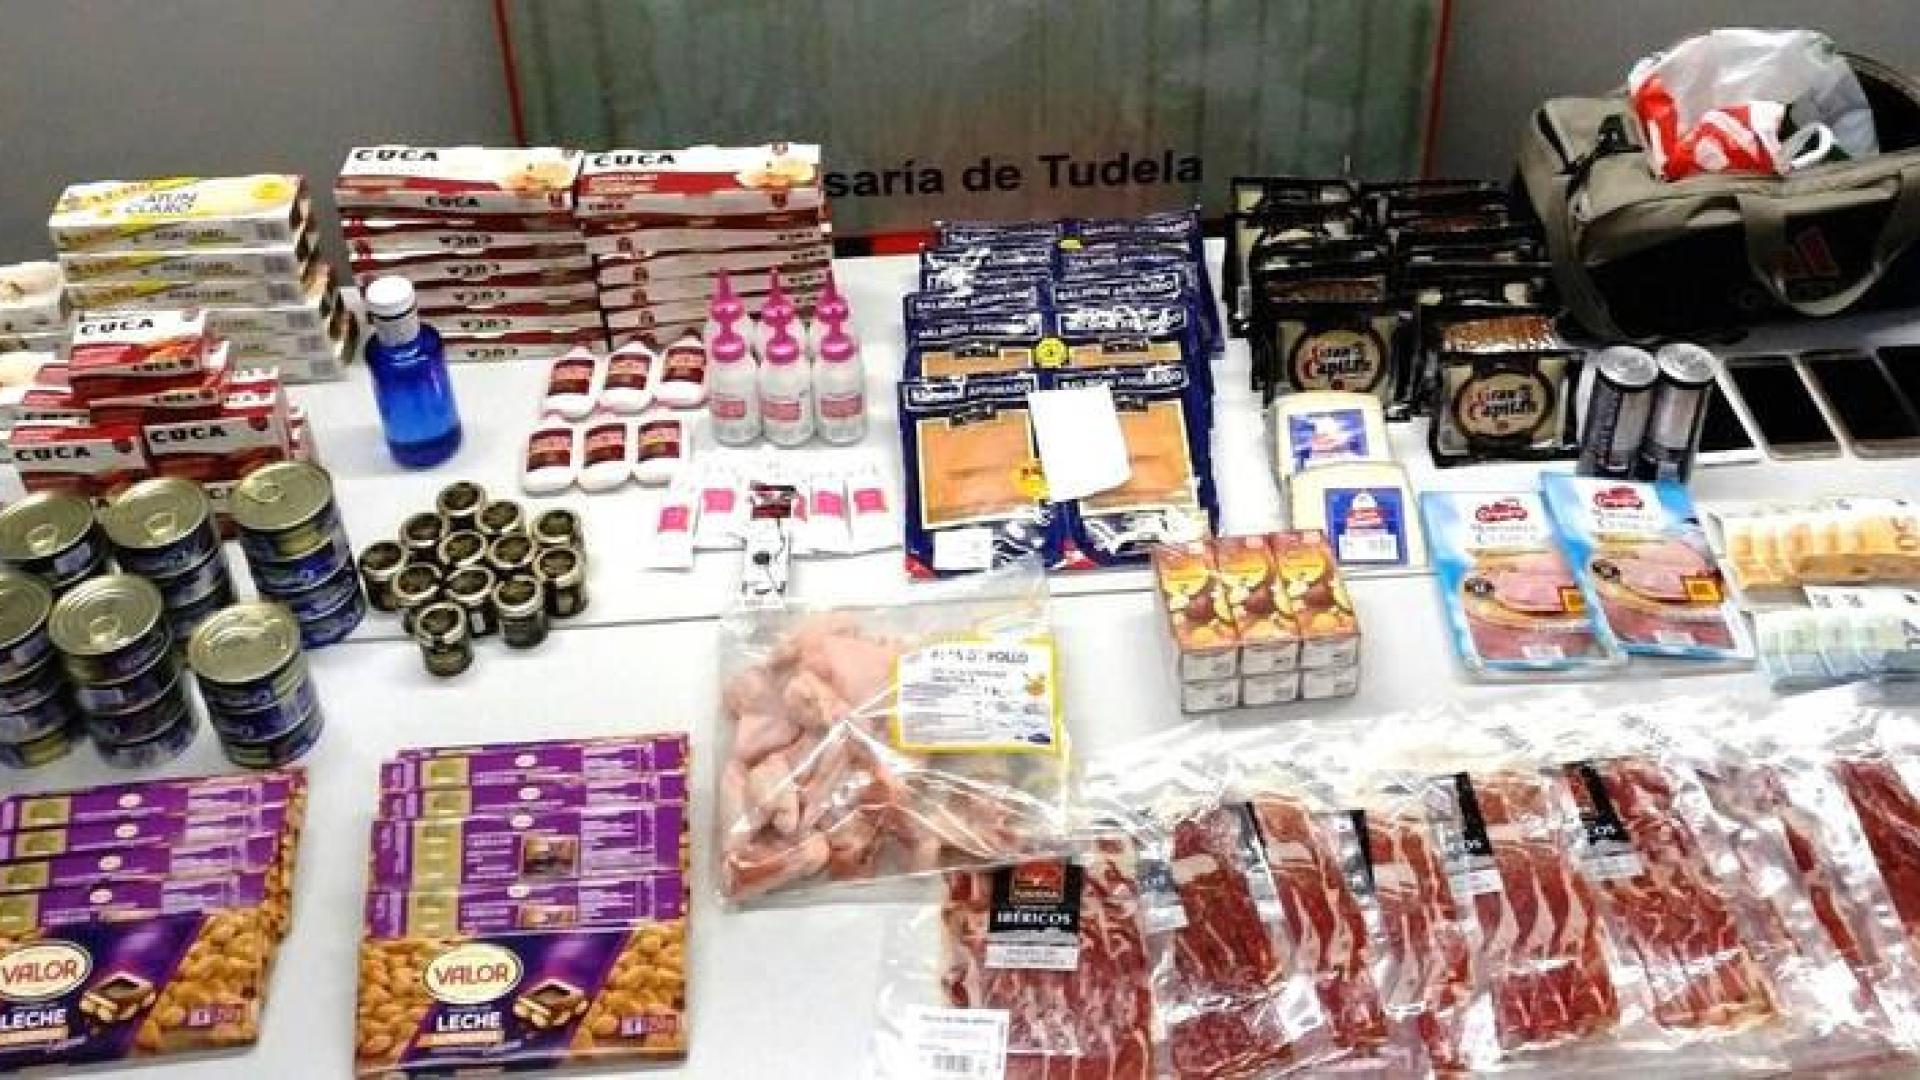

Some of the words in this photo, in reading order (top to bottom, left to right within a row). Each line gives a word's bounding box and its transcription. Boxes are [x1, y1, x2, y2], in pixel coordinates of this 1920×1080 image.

[353, 149, 438, 162] CUCA
[593, 153, 675, 167] CUCA
[962, 157, 1021, 192] de
[1038, 149, 1202, 189] Tudela
[425, 196, 480, 207] CUCA
[79, 319, 155, 334] CUCA
[149, 424, 228, 443] CUCA
[14, 446, 91, 462] CUCA
[1, 959, 78, 984] VALOR
[434, 961, 510, 987] VALOR
[1, 1008, 67, 1028] LECHE
[436, 1011, 502, 1032] LECHE
